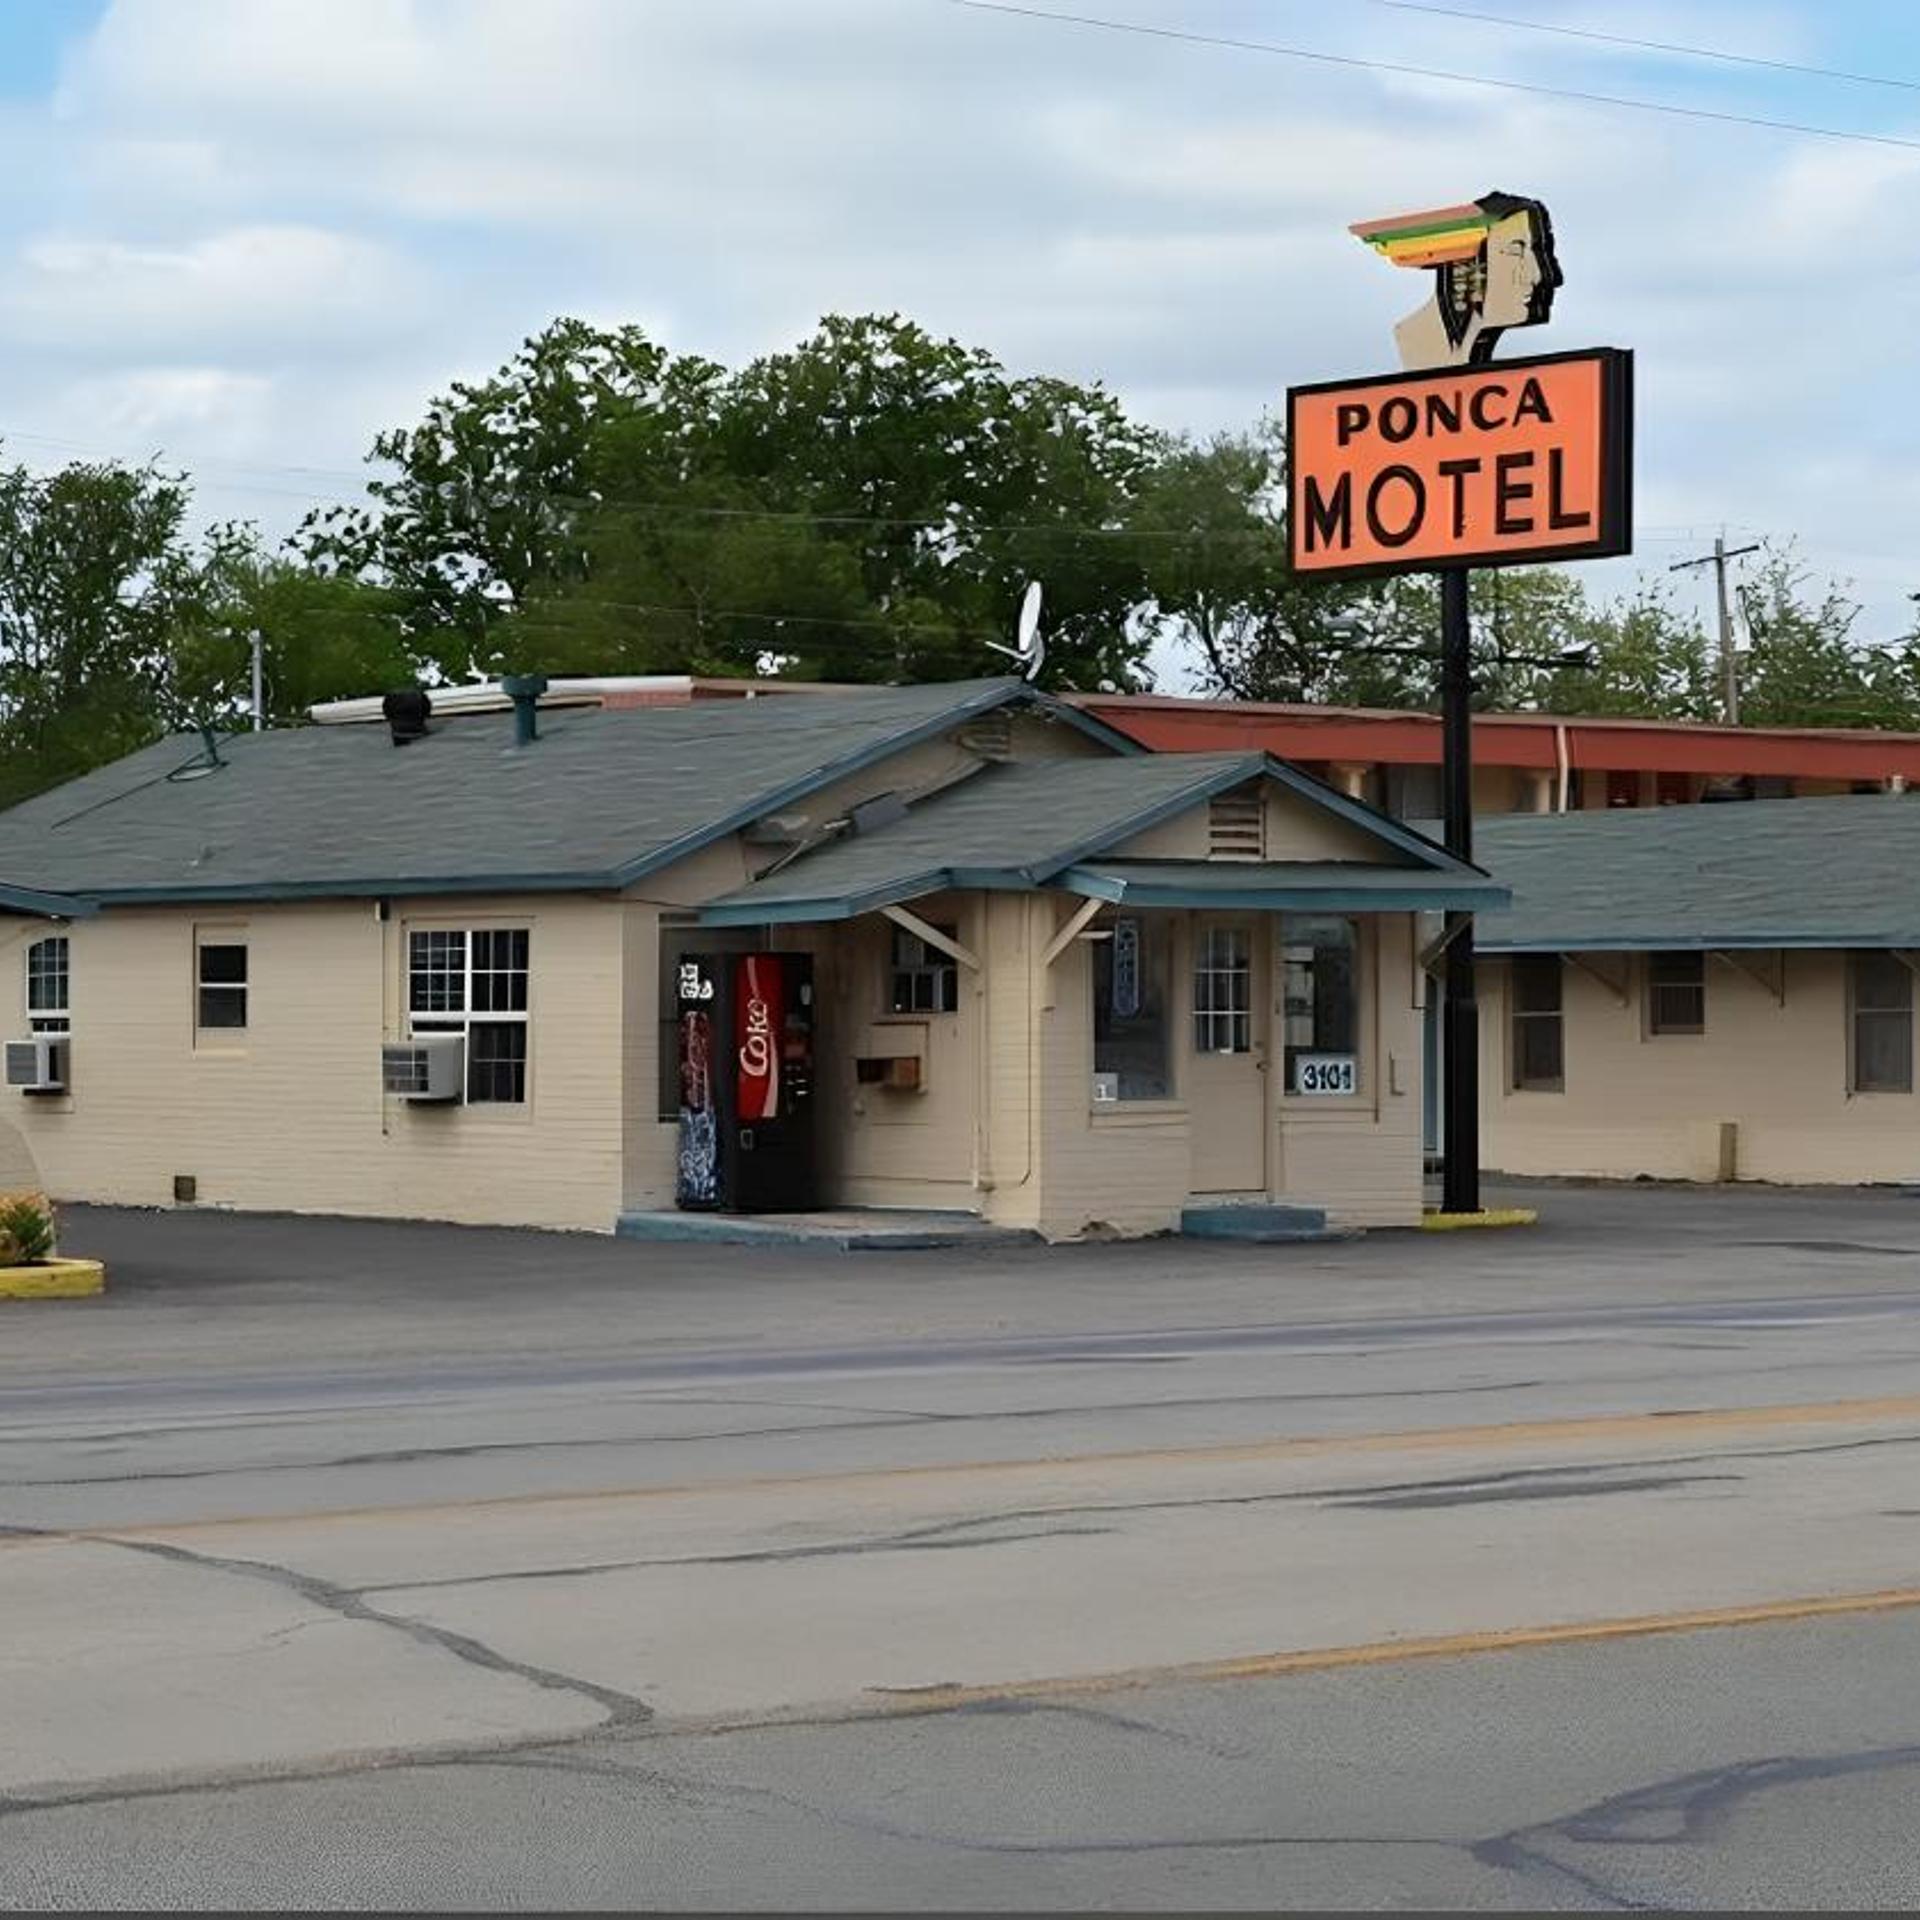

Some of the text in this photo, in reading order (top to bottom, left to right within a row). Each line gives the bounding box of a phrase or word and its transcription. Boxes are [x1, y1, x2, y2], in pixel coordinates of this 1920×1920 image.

[1336, 376, 1553, 446] PONCA
[1304, 447, 1591, 553] MOTEL
[740, 999, 768, 1076] Coke
[1304, 1064, 1351, 1089] 3101
